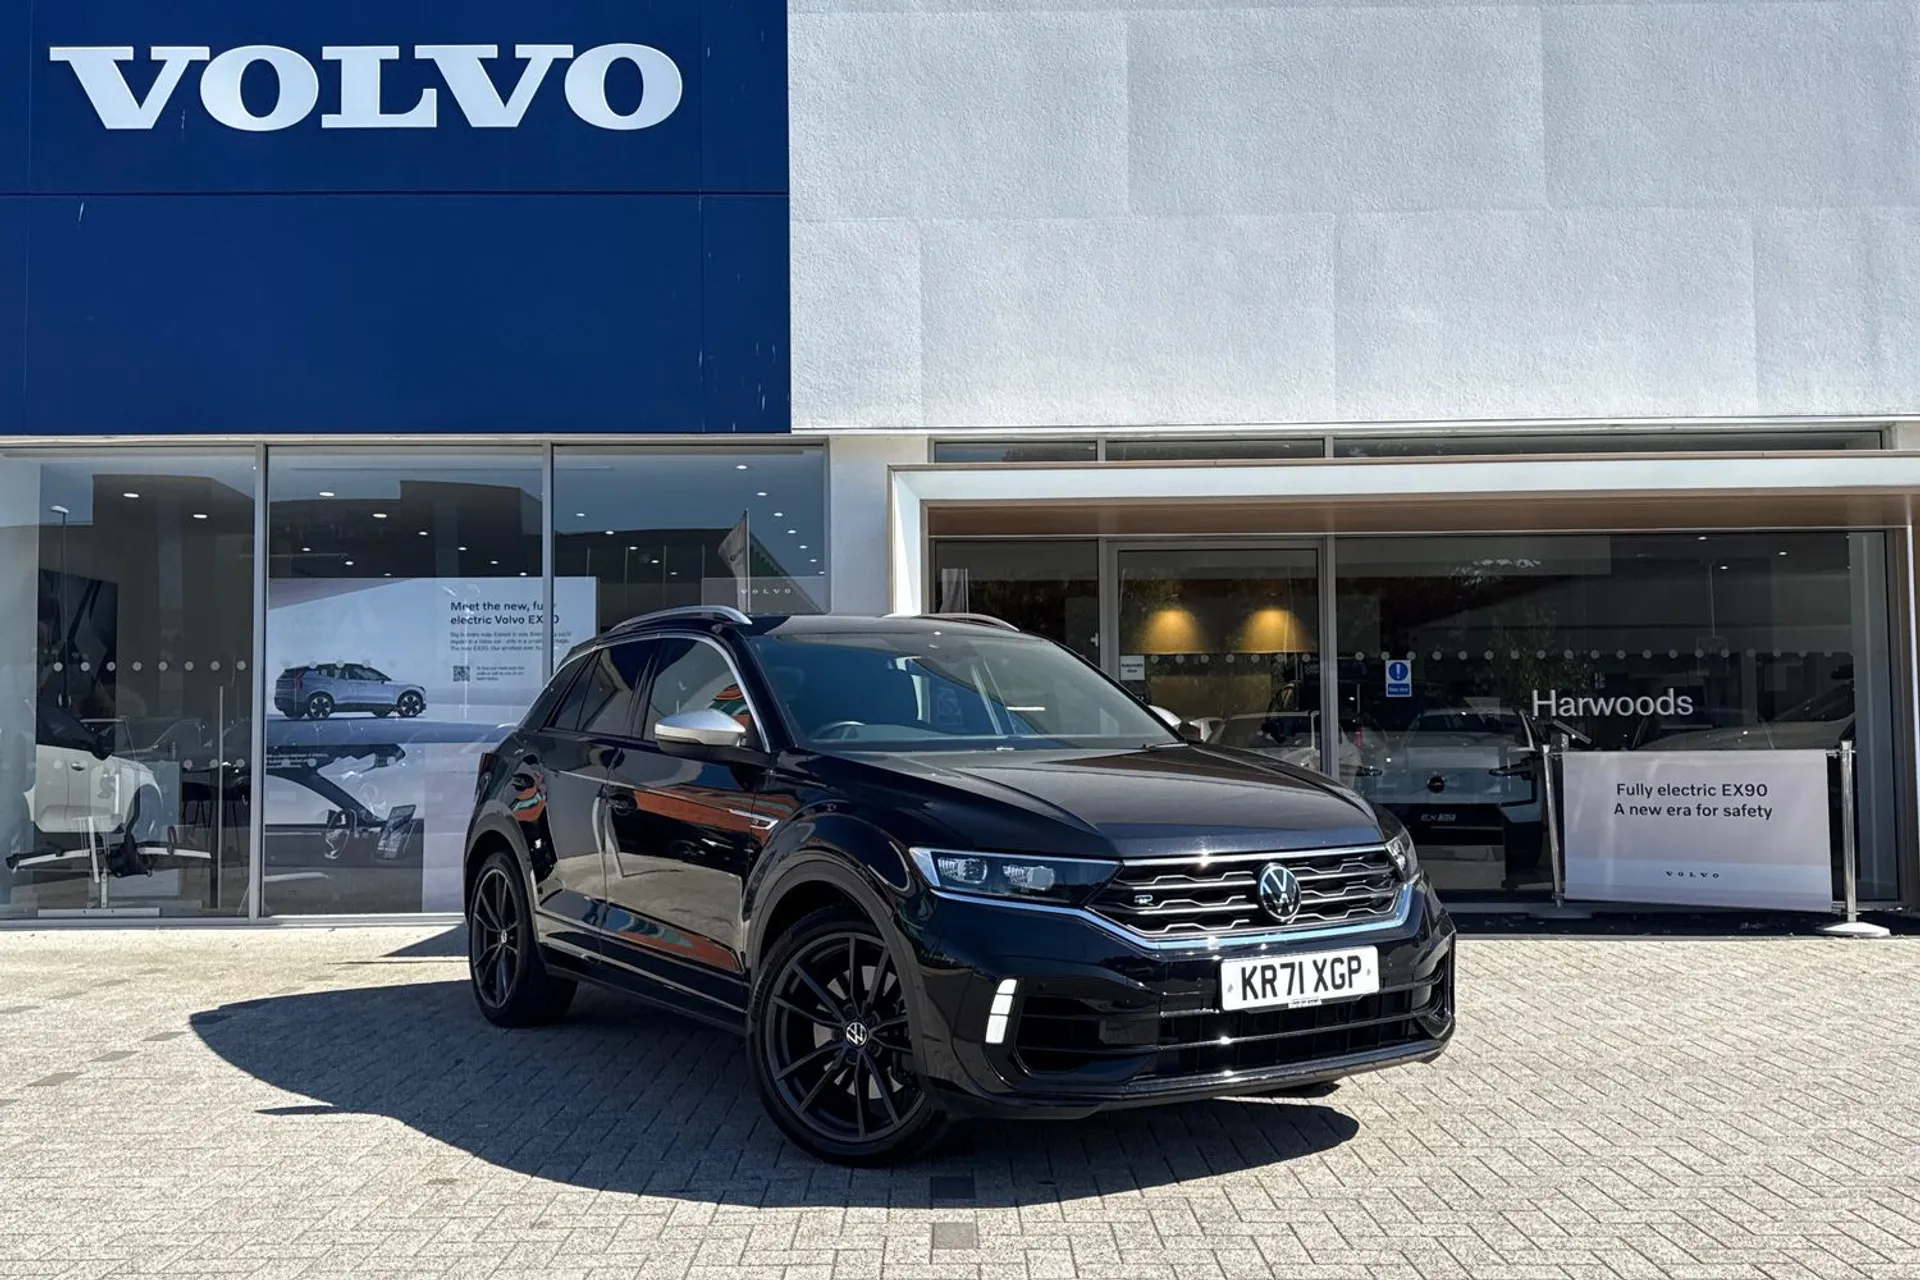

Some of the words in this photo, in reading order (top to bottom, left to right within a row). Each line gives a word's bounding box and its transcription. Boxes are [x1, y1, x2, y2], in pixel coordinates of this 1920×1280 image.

[49, 43, 683, 131] VOLVO
[450, 601, 479, 611] Meet
[482, 601, 501, 611] the
[503, 602, 530, 612] new,
[450, 614, 492, 625] electric
[494, 615, 525, 625] Volvo
[1532, 687, 1694, 717] Harwoods
[1616, 783, 1653, 799] Fully
[1657, 783, 1717, 797] electric
[1721, 783, 1768, 797] EX90
[1613, 802, 1625, 815] A
[1629, 805, 1662, 816] new
[1666, 806, 1692, 817] era
[1695, 803, 1719, 817] for
[1723, 803, 1773, 820] safety
[1665, 871, 1719, 879] VOLVO
[1241, 961, 1305, 1001] KR71
[1312, 955, 1362, 993] XGP
